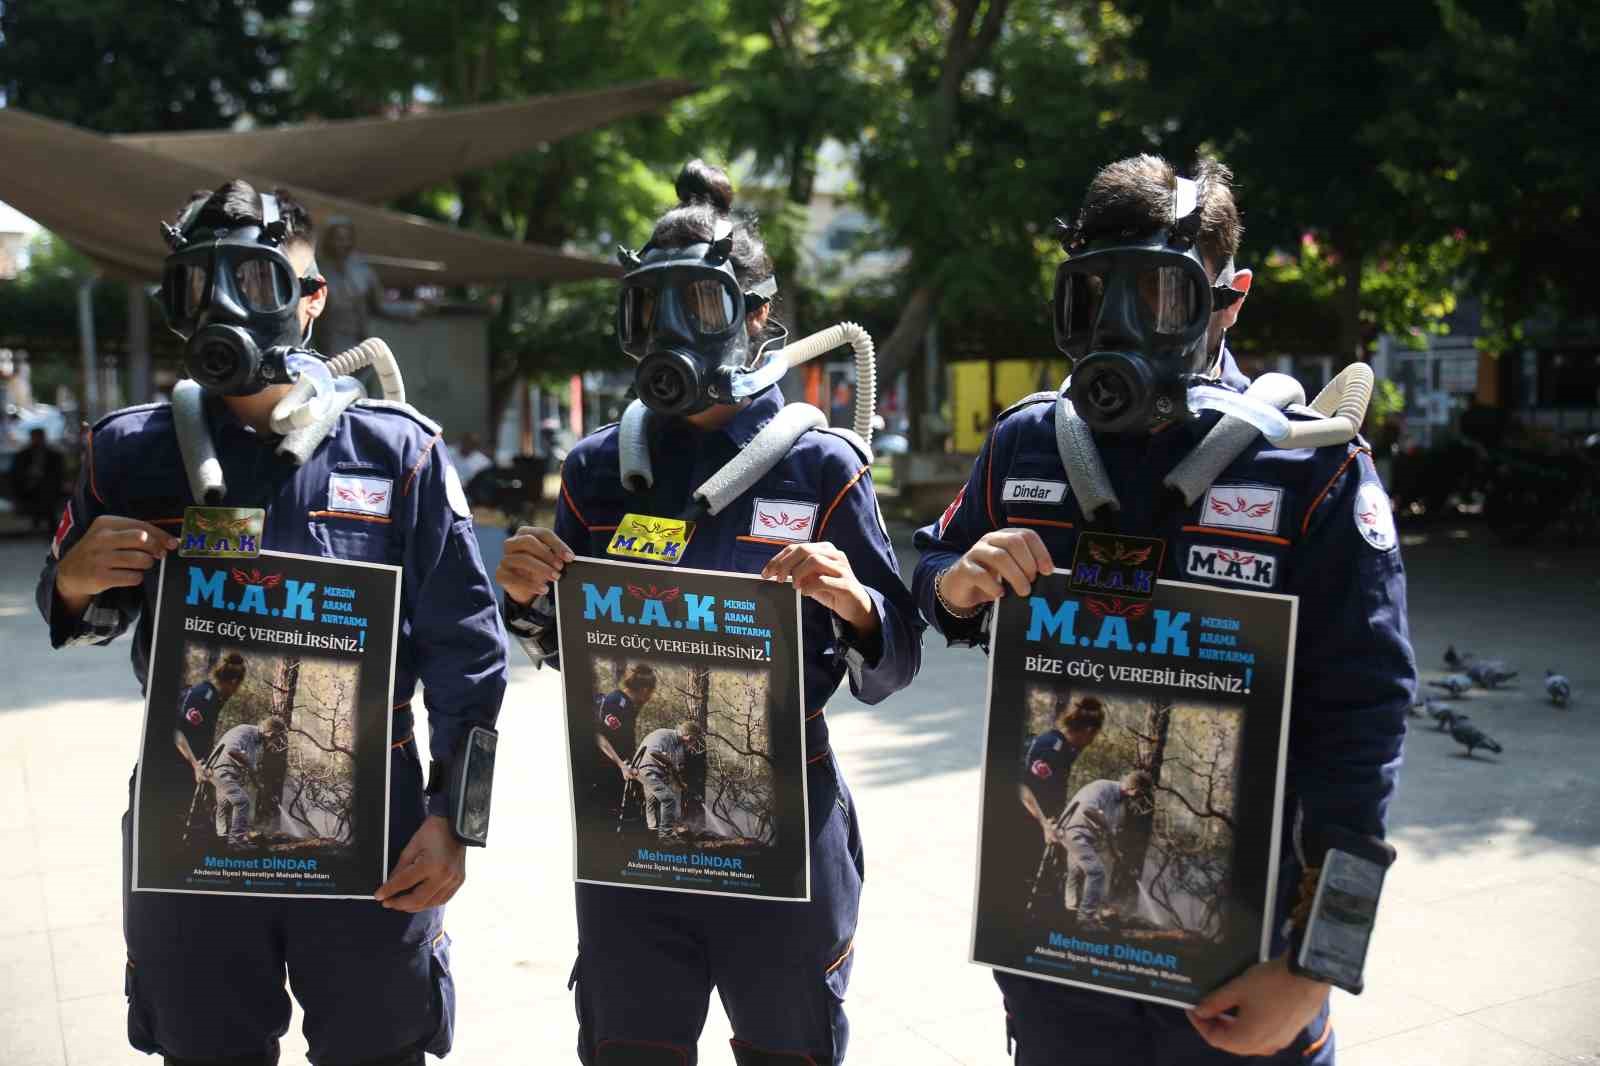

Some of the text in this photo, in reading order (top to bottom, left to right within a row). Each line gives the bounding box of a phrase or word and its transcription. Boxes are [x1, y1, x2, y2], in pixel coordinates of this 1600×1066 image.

[1013, 484, 1052, 499] Dindar
[1190, 549, 1273, 584] M.A.K
[185, 566, 317, 621] M.A.K
[581, 583, 718, 632] M.A.K
[185, 616, 215, 634] BİZE
[217, 621, 247, 641] GÜÇ
[1026, 597, 1191, 657] M.A.K
[587, 631, 617, 646] BİZE
[620, 634, 651, 653] GÜÇ
[1025, 654, 1063, 674] BİZE
[1067, 660, 1104, 681] GÜÇ
[204, 856, 318, 870] Mehmet DİNDAR
[638, 849, 742, 869] Mehmet DİNDAR
[1049, 931, 1177, 968] Mehmet DİNDAR
